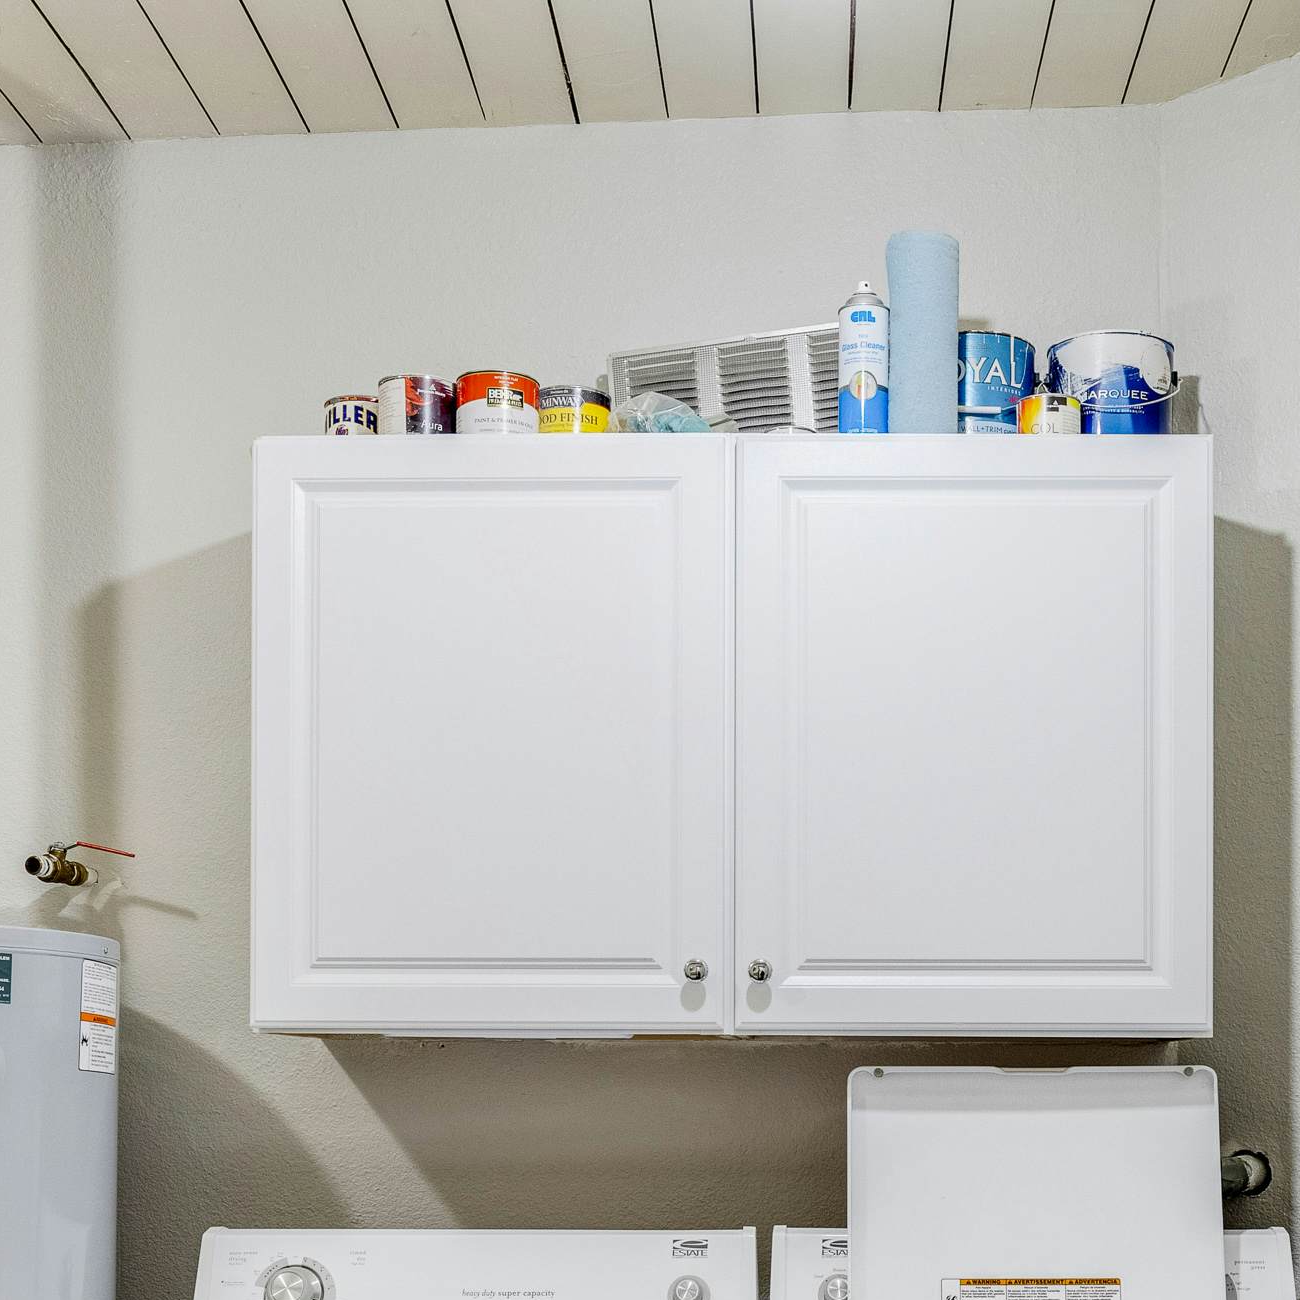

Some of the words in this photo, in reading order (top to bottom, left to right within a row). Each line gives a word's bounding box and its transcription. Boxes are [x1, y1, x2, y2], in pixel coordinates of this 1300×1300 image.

[958, 357, 1021, 388] OYAL
[325, 404, 378, 434] ILLER
[498, 1291, 521, 1299] super
[522, 1290, 555, 1299] capacity
